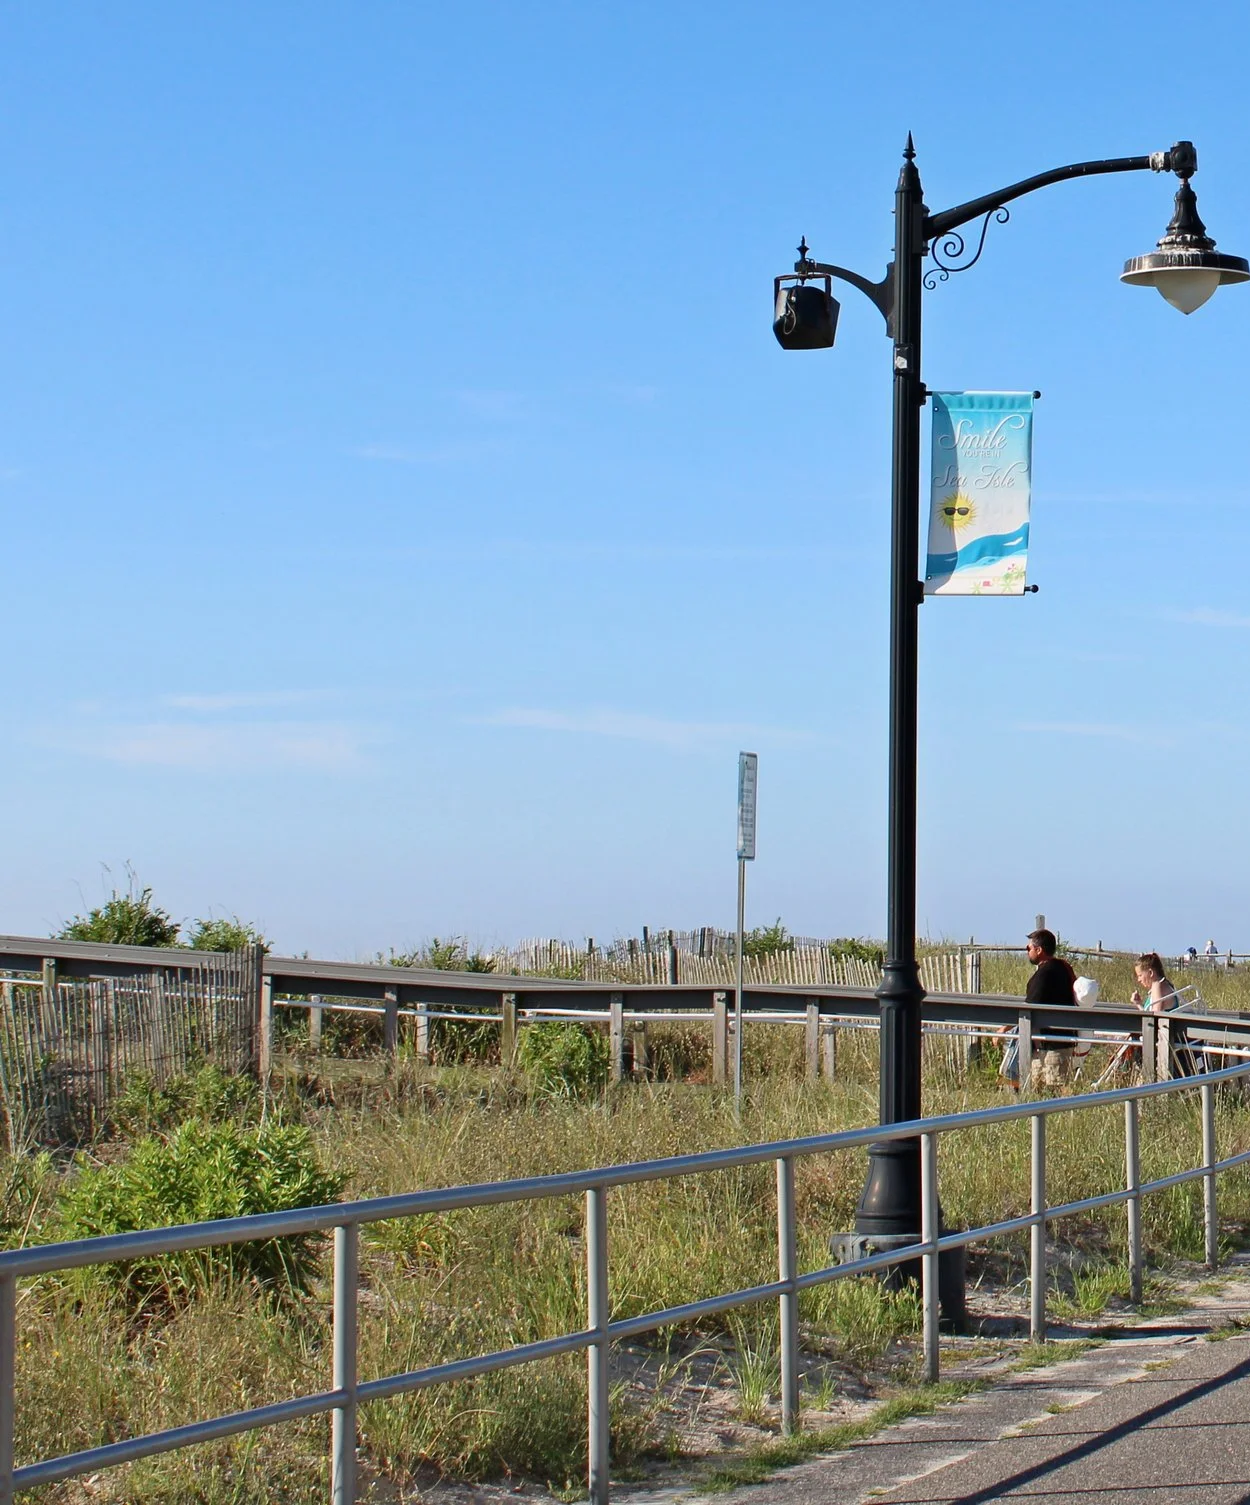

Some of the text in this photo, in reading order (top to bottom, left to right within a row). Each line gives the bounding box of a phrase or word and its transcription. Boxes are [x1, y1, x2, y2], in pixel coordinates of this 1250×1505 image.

[938, 413, 1025, 451] Smile
[932, 461, 1029, 490] Sea Isle
